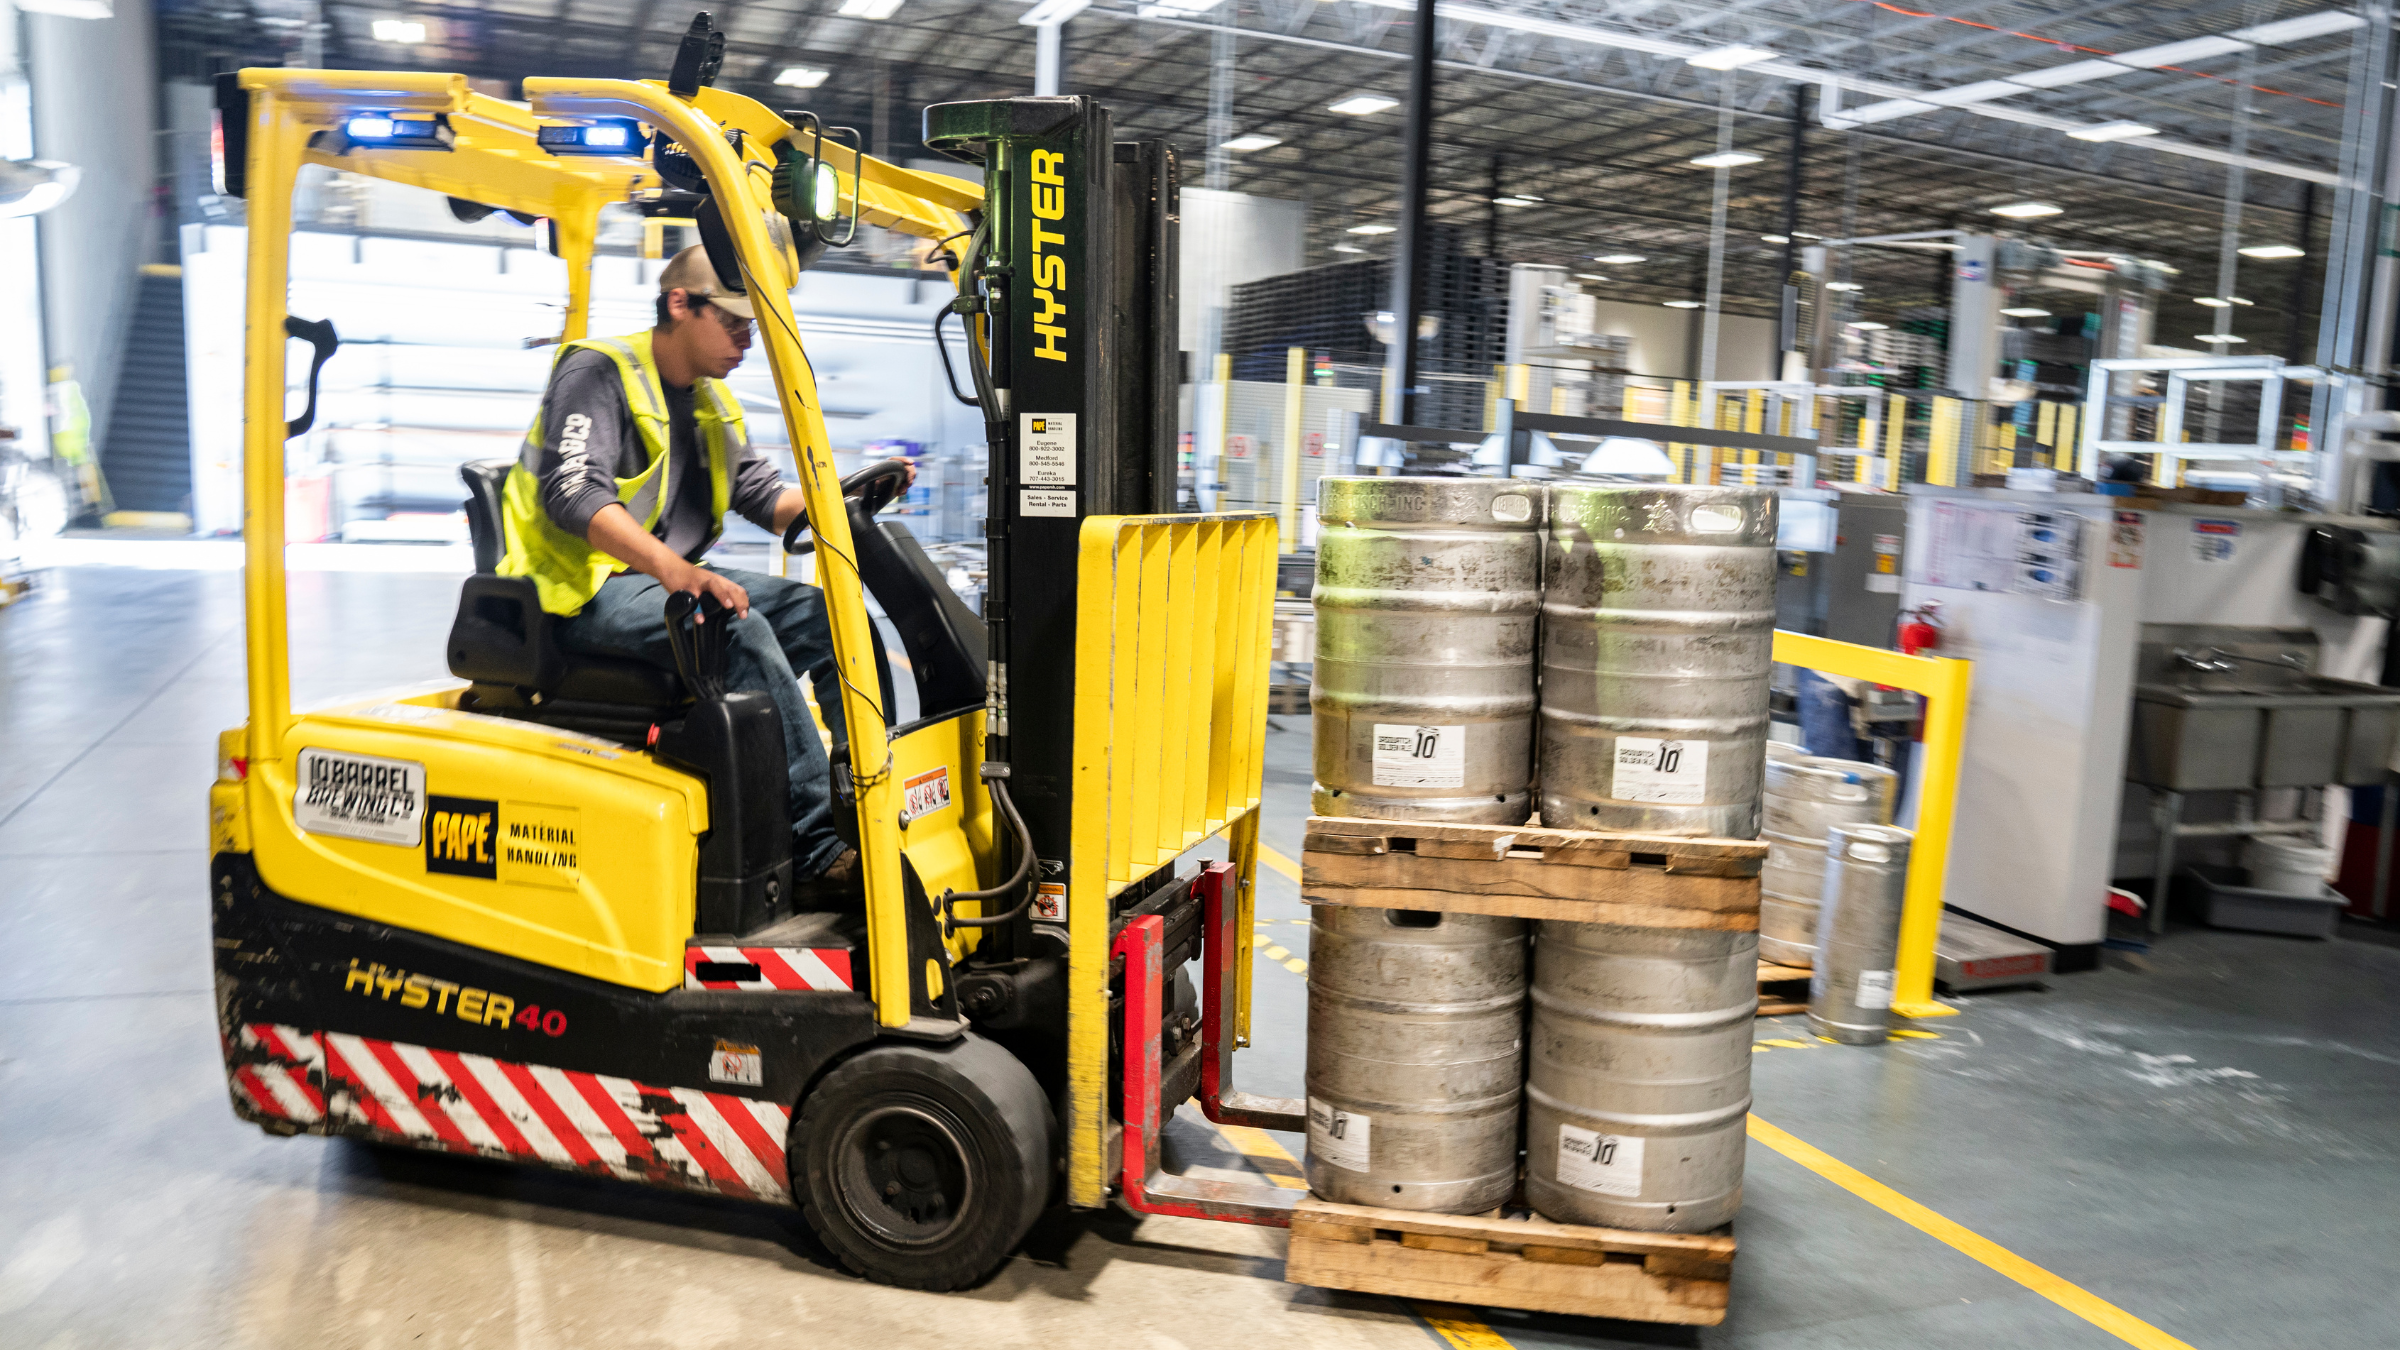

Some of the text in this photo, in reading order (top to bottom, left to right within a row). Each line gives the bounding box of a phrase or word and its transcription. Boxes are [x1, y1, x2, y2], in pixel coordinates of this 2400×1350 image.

[1031, 149, 1067, 362] HYSTER
[1413, 732, 1436, 758] 10
[1655, 746, 1679, 773] 10
[509, 822, 577, 846] MATERIAL
[507, 847, 577, 868] HANDLING
[344, 957, 568, 1038] HYSTER 40
